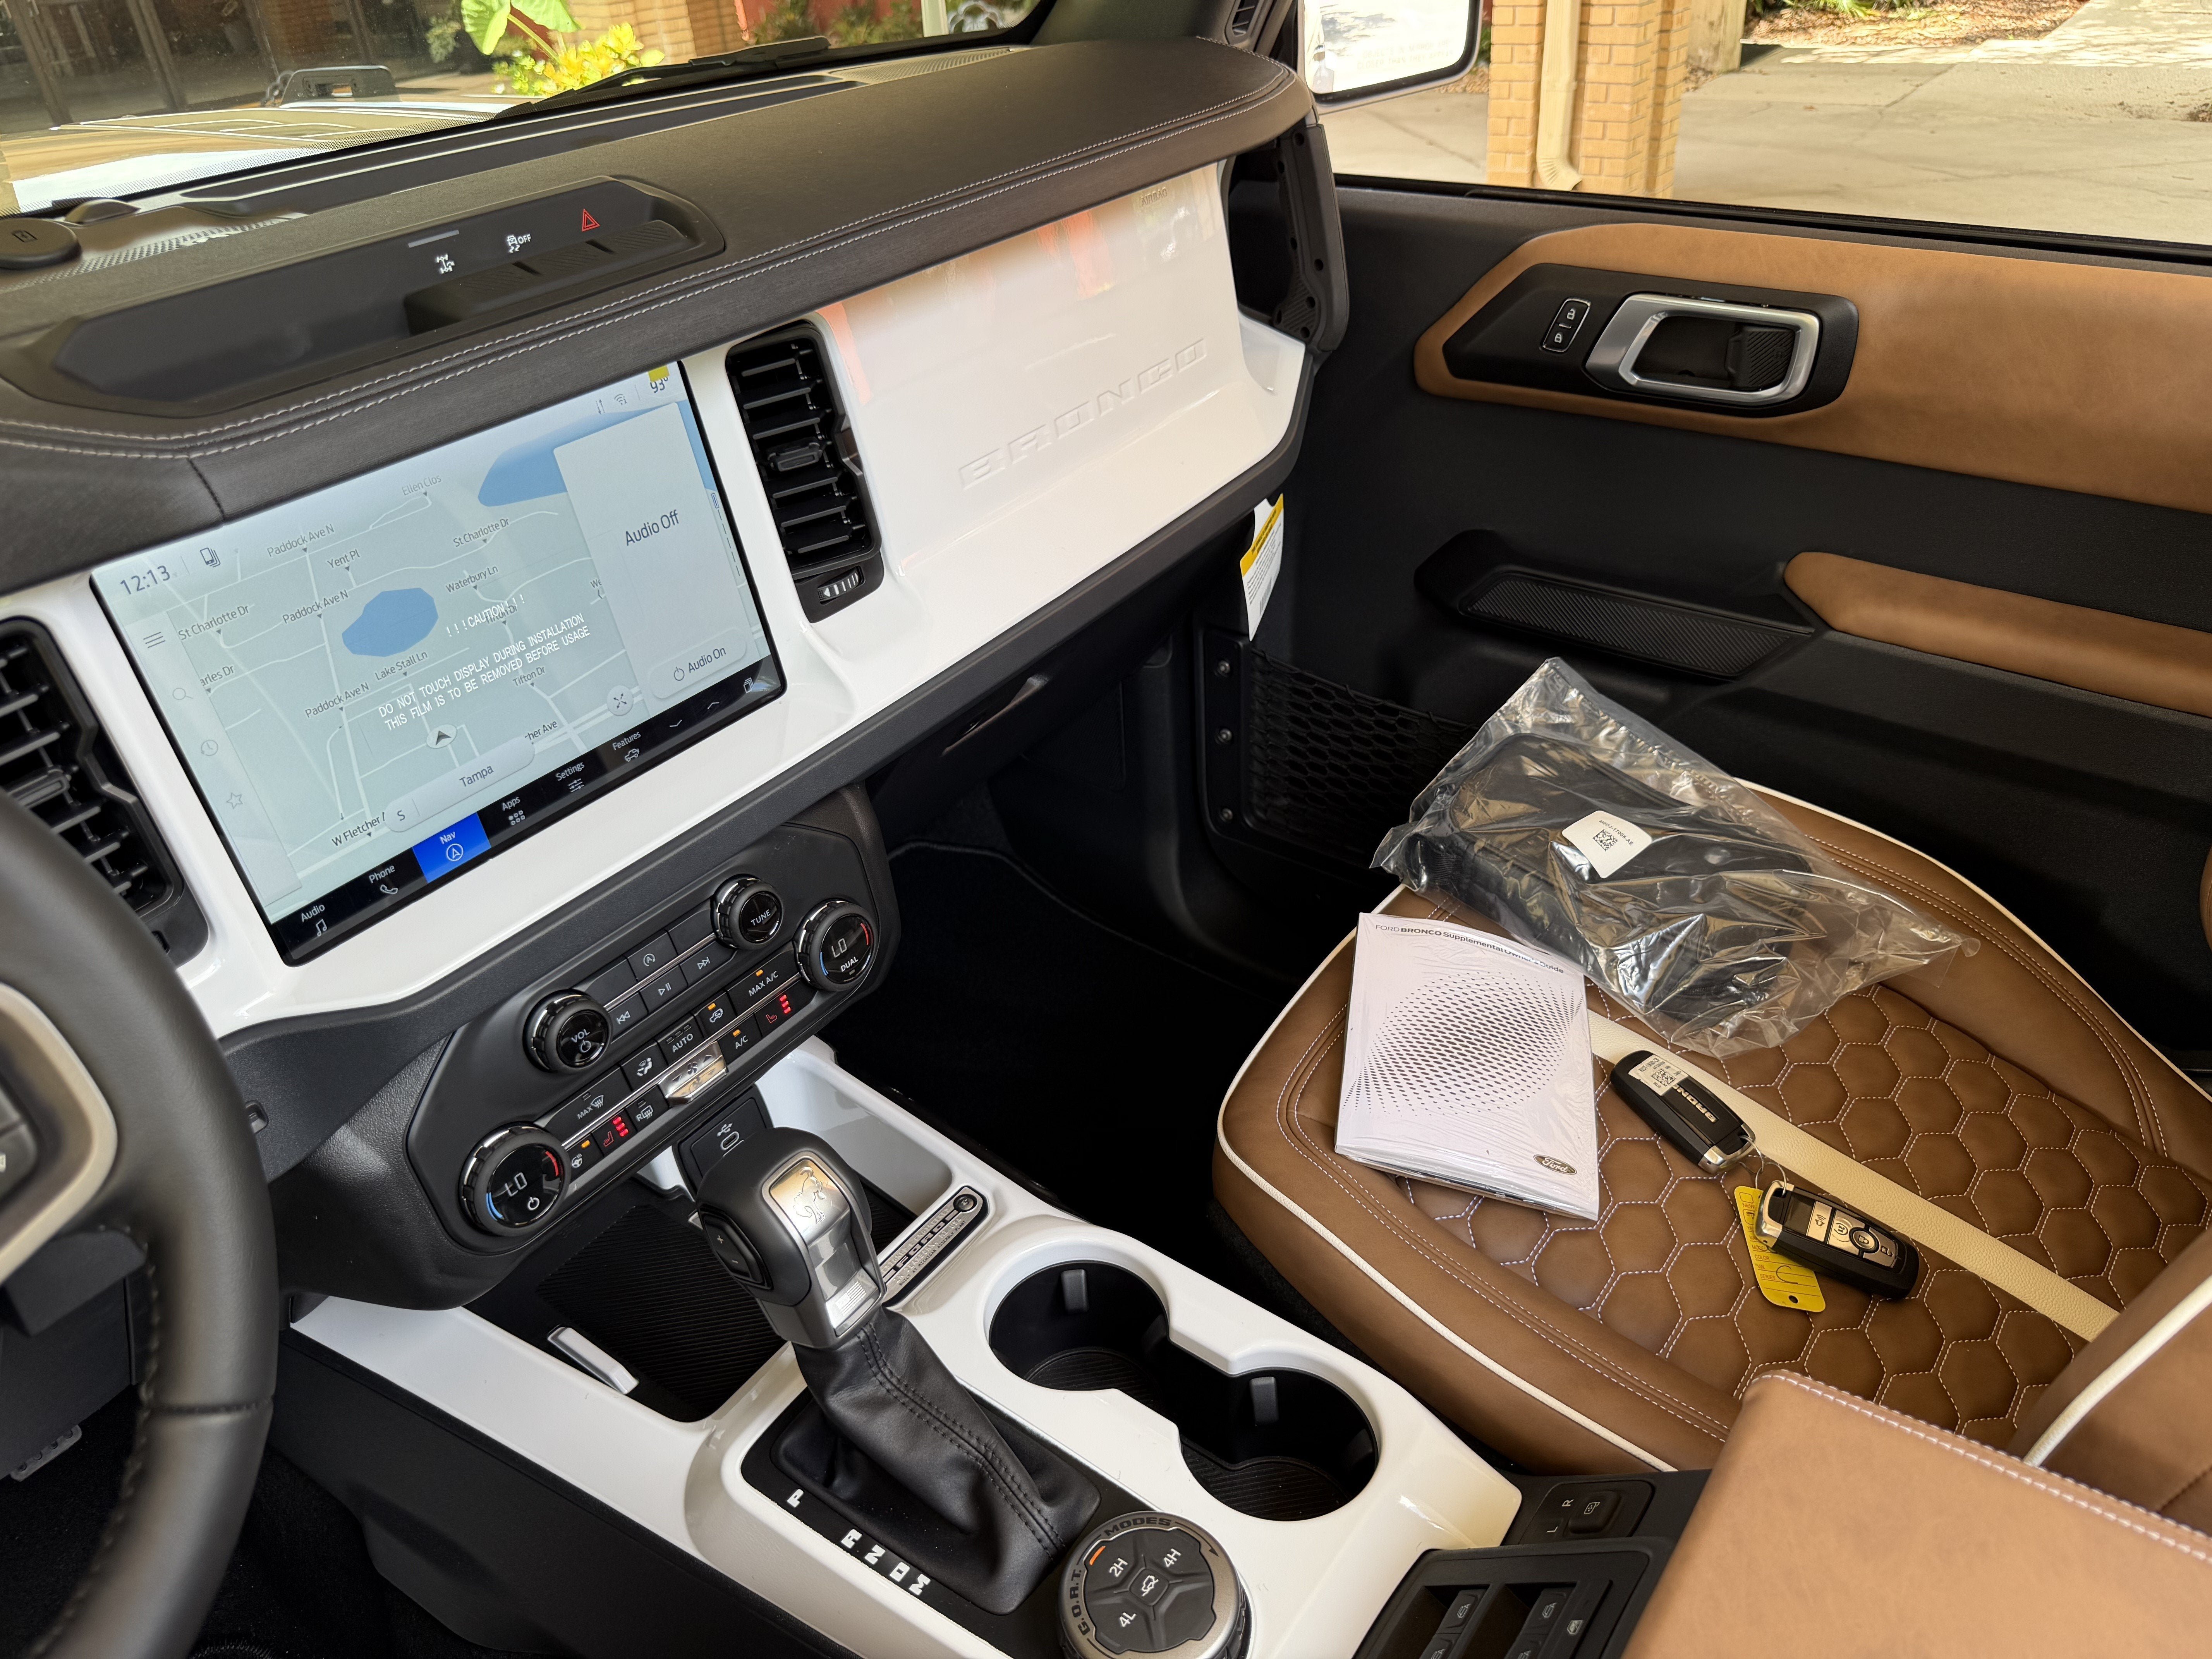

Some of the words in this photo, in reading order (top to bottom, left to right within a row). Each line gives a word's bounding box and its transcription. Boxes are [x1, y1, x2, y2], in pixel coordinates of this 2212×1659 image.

[1142, 188, 1167, 206] AIRBAG
[518, 234, 531, 244] OFF
[957, 338, 1208, 491] BRONCO
[402, 479, 422, 496] Ellen
[453, 536, 464, 548] St
[463, 523, 498, 543] Charlotte
[498, 517, 509, 529] Dr
[625, 521, 659, 546] Audio
[660, 509, 680, 530] Off
[267, 534, 307, 557] Paddock
[308, 529, 325, 544] Ave
[325, 524, 335, 536] N
[327, 553, 349, 570] Yent
[349, 549, 361, 562] Pl
[120, 565, 171, 596] 12:13
[446, 571, 484, 593] Waterbury
[486, 565, 499, 576] Ln
[283, 601, 321, 624] Paddock
[322, 596, 340, 609] Ave
[339, 590, 349, 603] N
[467, 603, 504, 628] CAUTION
[178, 629, 192, 640] St
[192, 612, 237, 634] Charlotte
[237, 605, 250, 617] Dr
[223, 665, 234, 676] Dr
[375, 666, 395, 680] Lake
[396, 656, 417, 671] Stall
[416, 651, 428, 661] Ln
[378, 703, 393, 718] DO
[397, 692, 416, 709] NOT
[419, 675, 452, 697] TOUCH
[454, 656, 490, 682] DISPLAY
[493, 641, 526, 663] DURING
[527, 613, 585, 647] INSTALLATION
[687, 654, 713, 674] Audio
[713, 646, 726, 659] On
[385, 714, 407, 731] THIS
[410, 701, 433, 719] FILM
[434, 696, 446, 707] IS
[448, 687, 462, 700] TO
[464, 678, 479, 694] BE
[480, 658, 523, 685] REMOVED
[526, 640, 560, 663] BEFORE
[562, 625, 591, 646] USAGE
[512, 671, 537, 687] Tifton
[536, 666, 546, 677] Dr
[306, 694, 344, 718] Paddock
[345, 688, 361, 701] Ave
[360, 682, 369, 692] N
[543, 721, 558, 733] Ave
[612, 731, 641, 750] Features
[459, 764, 495, 788] Tampa
[555, 761, 585, 781] Settings
[501, 796, 521, 812] Apps
[397, 809, 406, 822] S
[331, 835, 342, 847] W
[342, 817, 382, 842] Fletcher
[440, 830, 457, 845] Nav
[369, 864, 396, 884] Phone
[300, 902, 326, 922] Audio
[751, 908, 771, 926] TUNE
[1375, 924, 1400, 933] FORD
[1401, 927, 1443, 937] BRONCO
[1443, 932, 1503, 953] Supplemental
[840, 955, 860, 973] DUAL
[748, 980, 765, 997] MAX
[763, 970, 780, 987] A/C
[571, 1029, 591, 1044] VOL
[672, 1032, 694, 1053] AUTO
[735, 1034, 749, 1050] A/C
[577, 1105, 593, 1120] MAX
[1542, 1157, 1568, 1173] Ford
[896, 1222, 945, 1268] FORD
[899, 1274, 912, 1286] BUILT
[918, 1249, 937, 1267] MICHIGAN
[937, 1232, 954, 1248] ASSEMBLY
[955, 1221, 966, 1231] PLANT
[880, 1247, 908, 1274] ESIGNED
[1561, 1499, 1574, 1507] R
[1104, 1516, 1172, 1536] MODES
[787, 1489, 804, 1508] P
[864, 1544, 886, 1565] N
[890, 1562, 910, 1582] D
[909, 1573, 931, 1595] M
[1109, 1558, 1128, 1577] 2H
[1163, 1548, 1181, 1568] 4H
[1119, 1612, 1137, 1627] 4L
